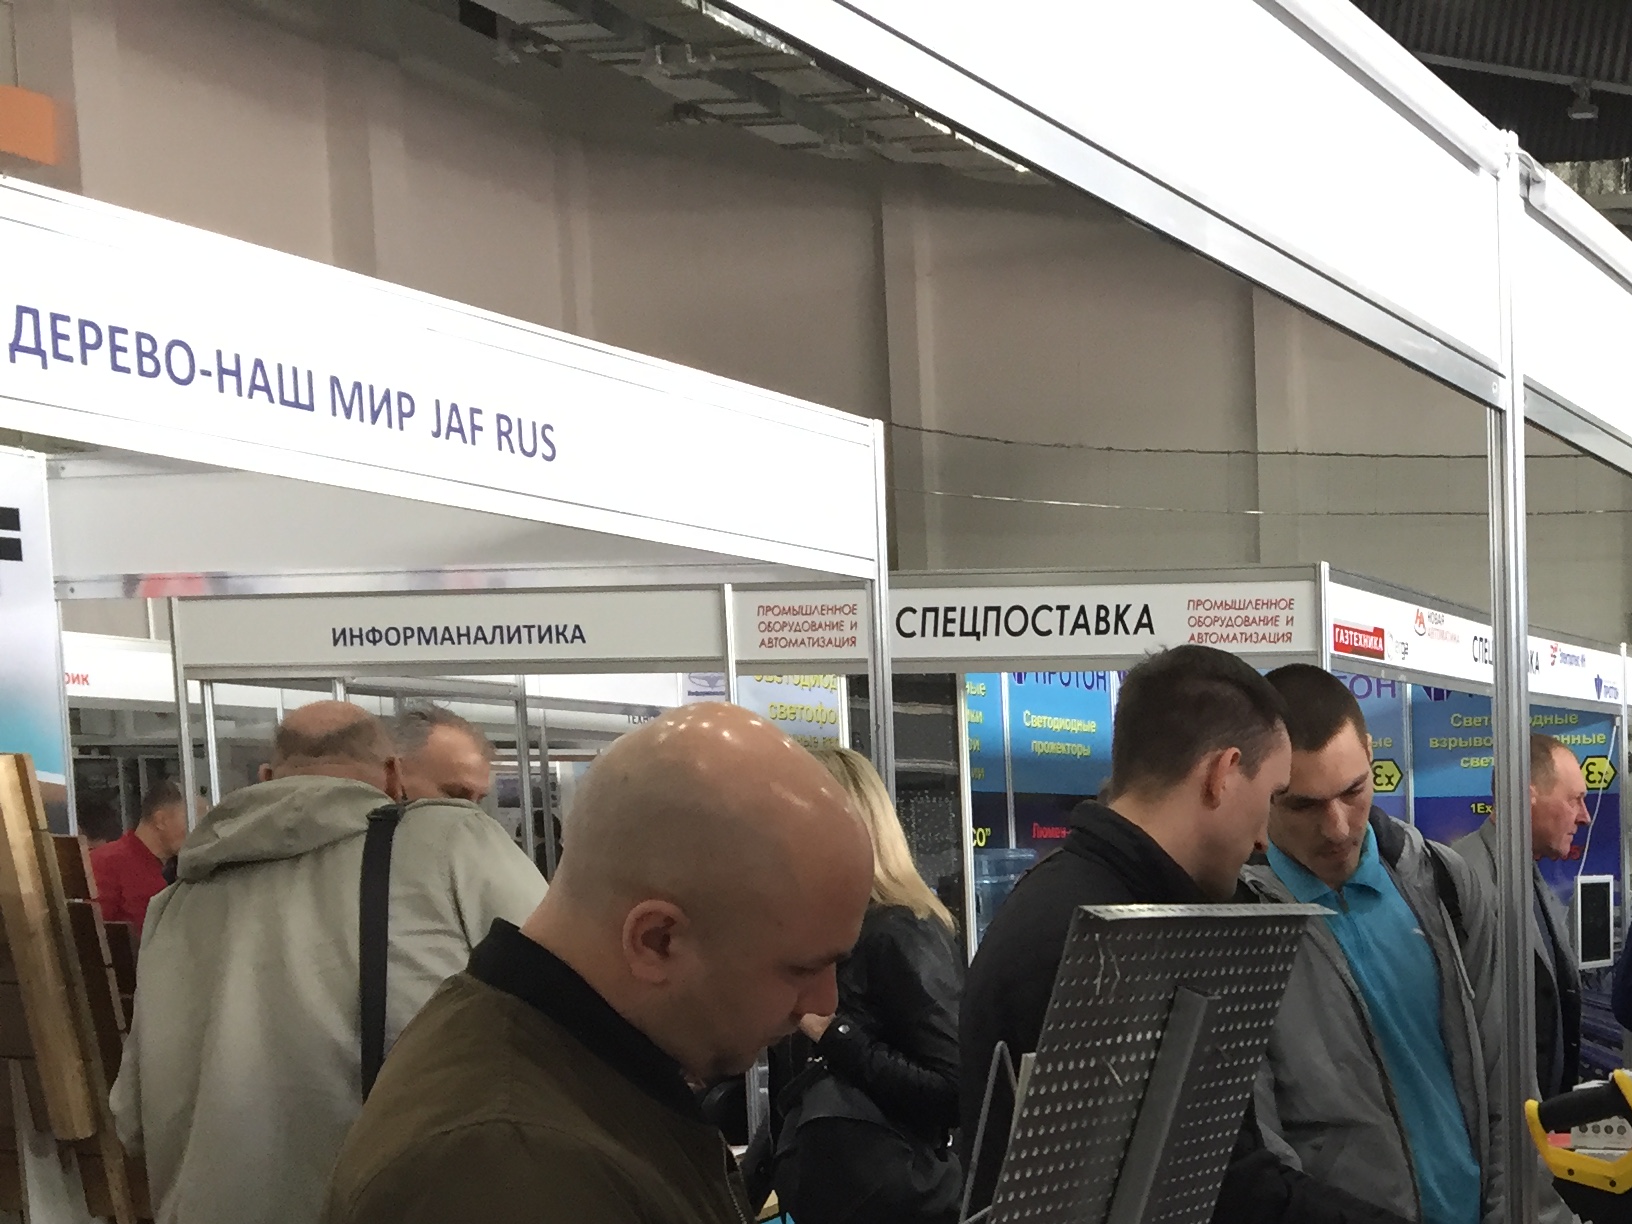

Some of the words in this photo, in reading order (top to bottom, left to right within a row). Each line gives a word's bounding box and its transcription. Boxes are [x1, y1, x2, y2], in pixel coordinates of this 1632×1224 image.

[8, 304, 315, 412] ДЕРЕВО-НАШ
[329, 375, 416, 432] МИР
[430, 398, 484, 446] JAF
[495, 412, 557, 462] RUS
[757, 604, 858, 616] ПРОМЫШЛЕННОЕ
[1187, 598, 1295, 611] ПРОМЫШЛЕННОЕ
[758, 620, 845, 633] ОБОРУДОВАНИЕ
[850, 620, 858, 632] И
[896, 603, 1156, 641] СПЕЦПОСТАВКА
[1187, 615, 1280, 628] ОБОРУДОВАНИЕ
[1286, 615, 1294, 627] И
[331, 624, 587, 647] ИНФОРМАНАЛИТИКА
[758, 636, 857, 648] АВТОМАТИЗАЦИЯ
[1187, 632, 1293, 645] АВТОМАТИЗАЦИЯ
[1335, 627, 1383, 651] ГАЗТЕХНИКА
[1022, 709, 1097, 733] Светодиодные
